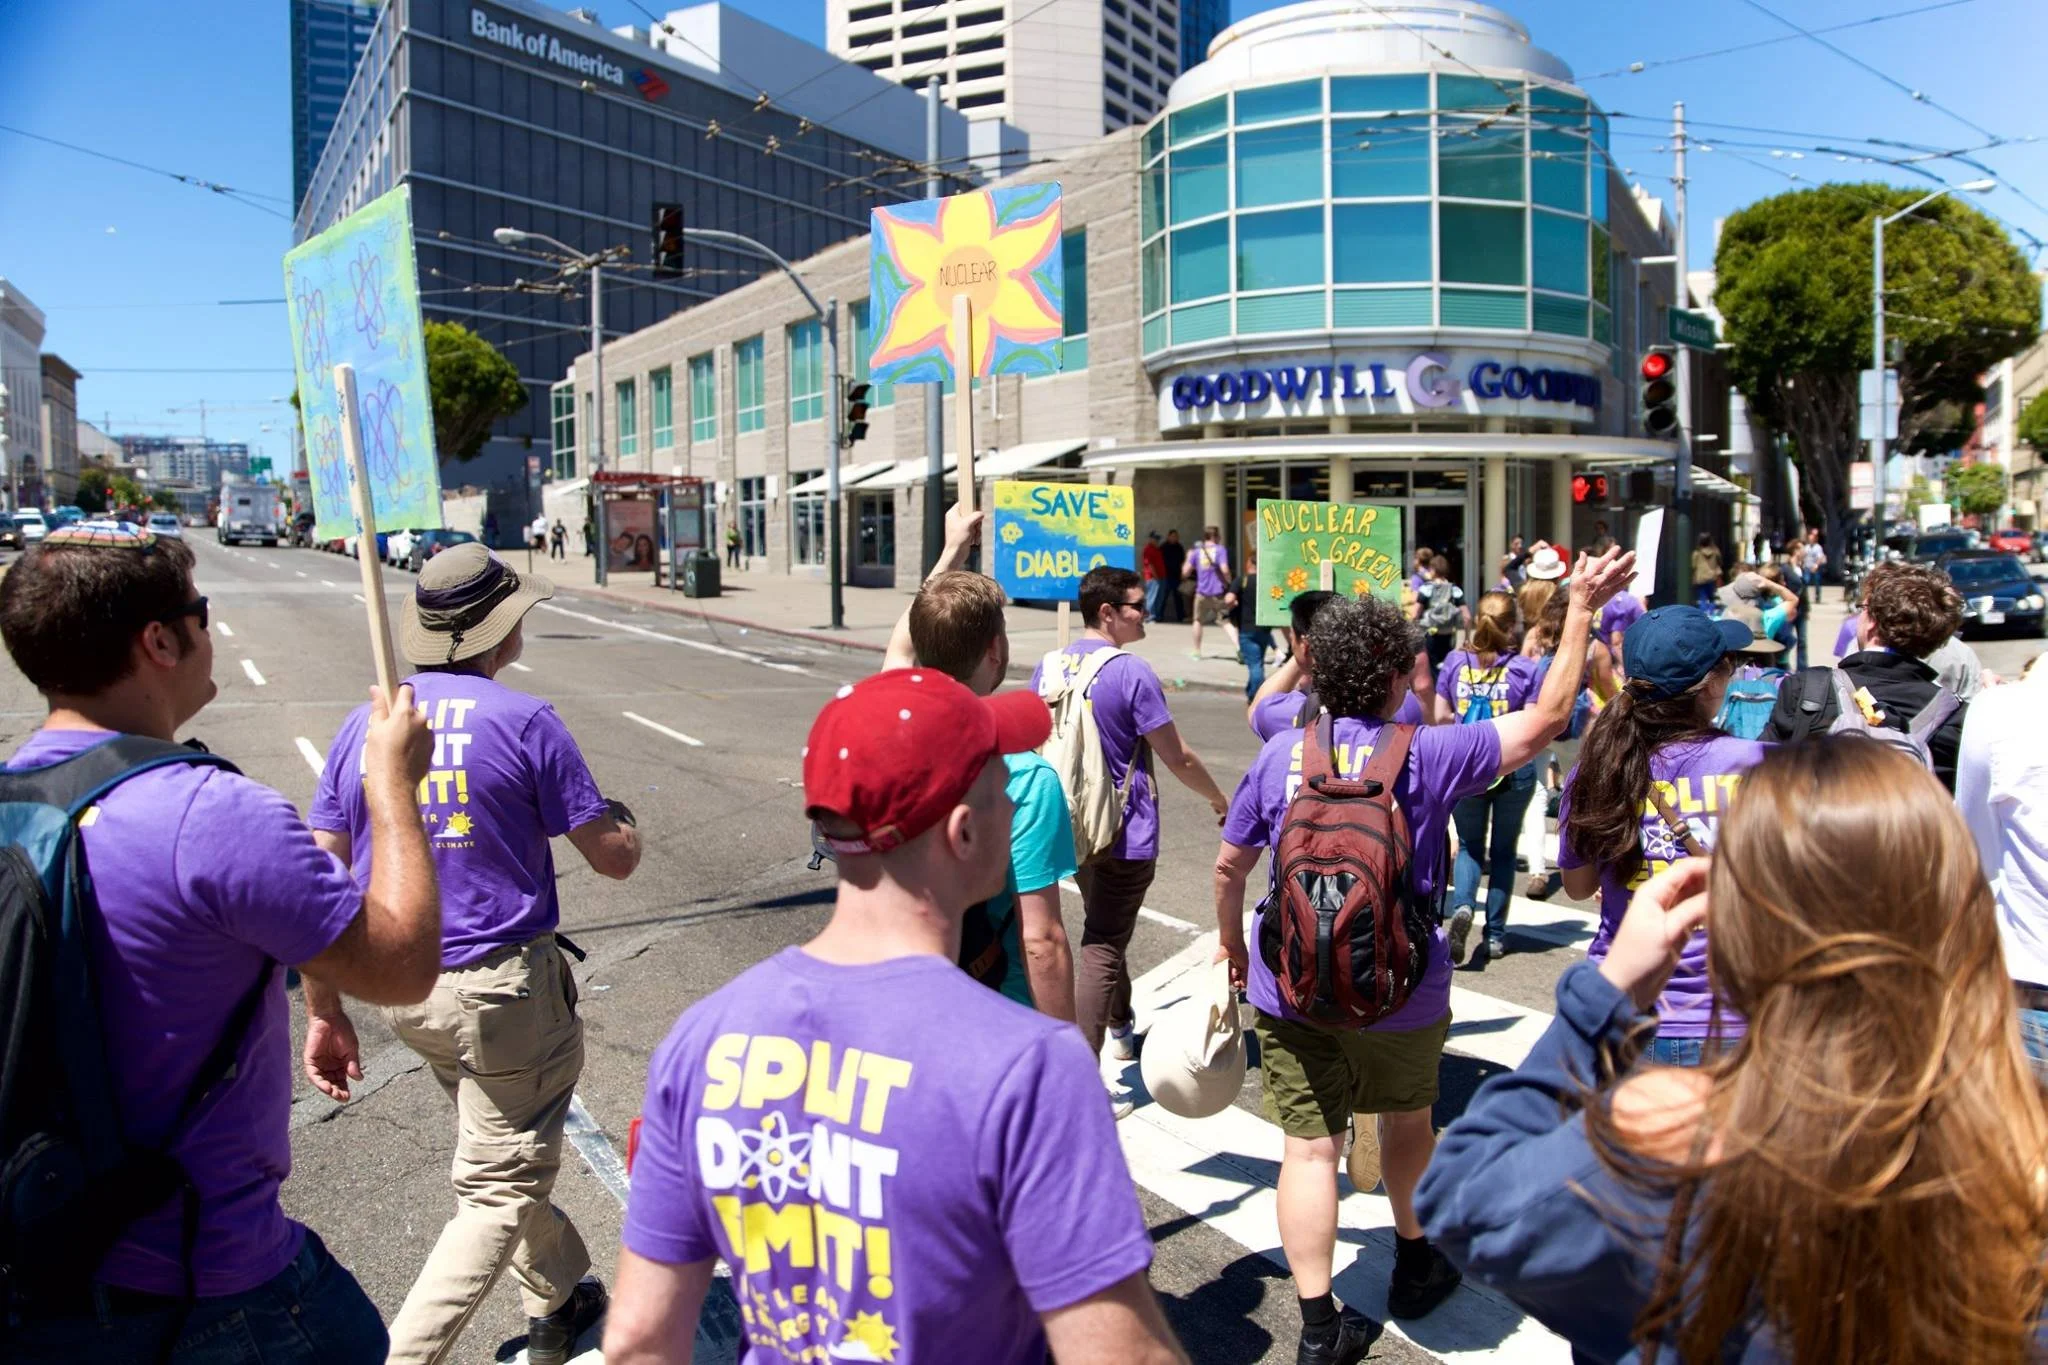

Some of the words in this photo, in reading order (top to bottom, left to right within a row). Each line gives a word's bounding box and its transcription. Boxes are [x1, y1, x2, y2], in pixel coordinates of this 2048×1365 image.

[471, 8, 525, 51] Bank
[526, 33, 548, 58] of
[547, 39, 624, 85] America
[940, 260, 997, 286] NUCLEAR
[1172, 363, 1396, 411] GOODWILL
[1031, 487, 1108, 519] SAVE
[1262, 502, 1378, 541] NUCLEAR
[1301, 538, 1321, 565] IS
[1329, 535, 1400, 590] GREEN
[436, 840, 475, 849] CLIMATE
[702, 1033, 913, 1135] SPLIT
